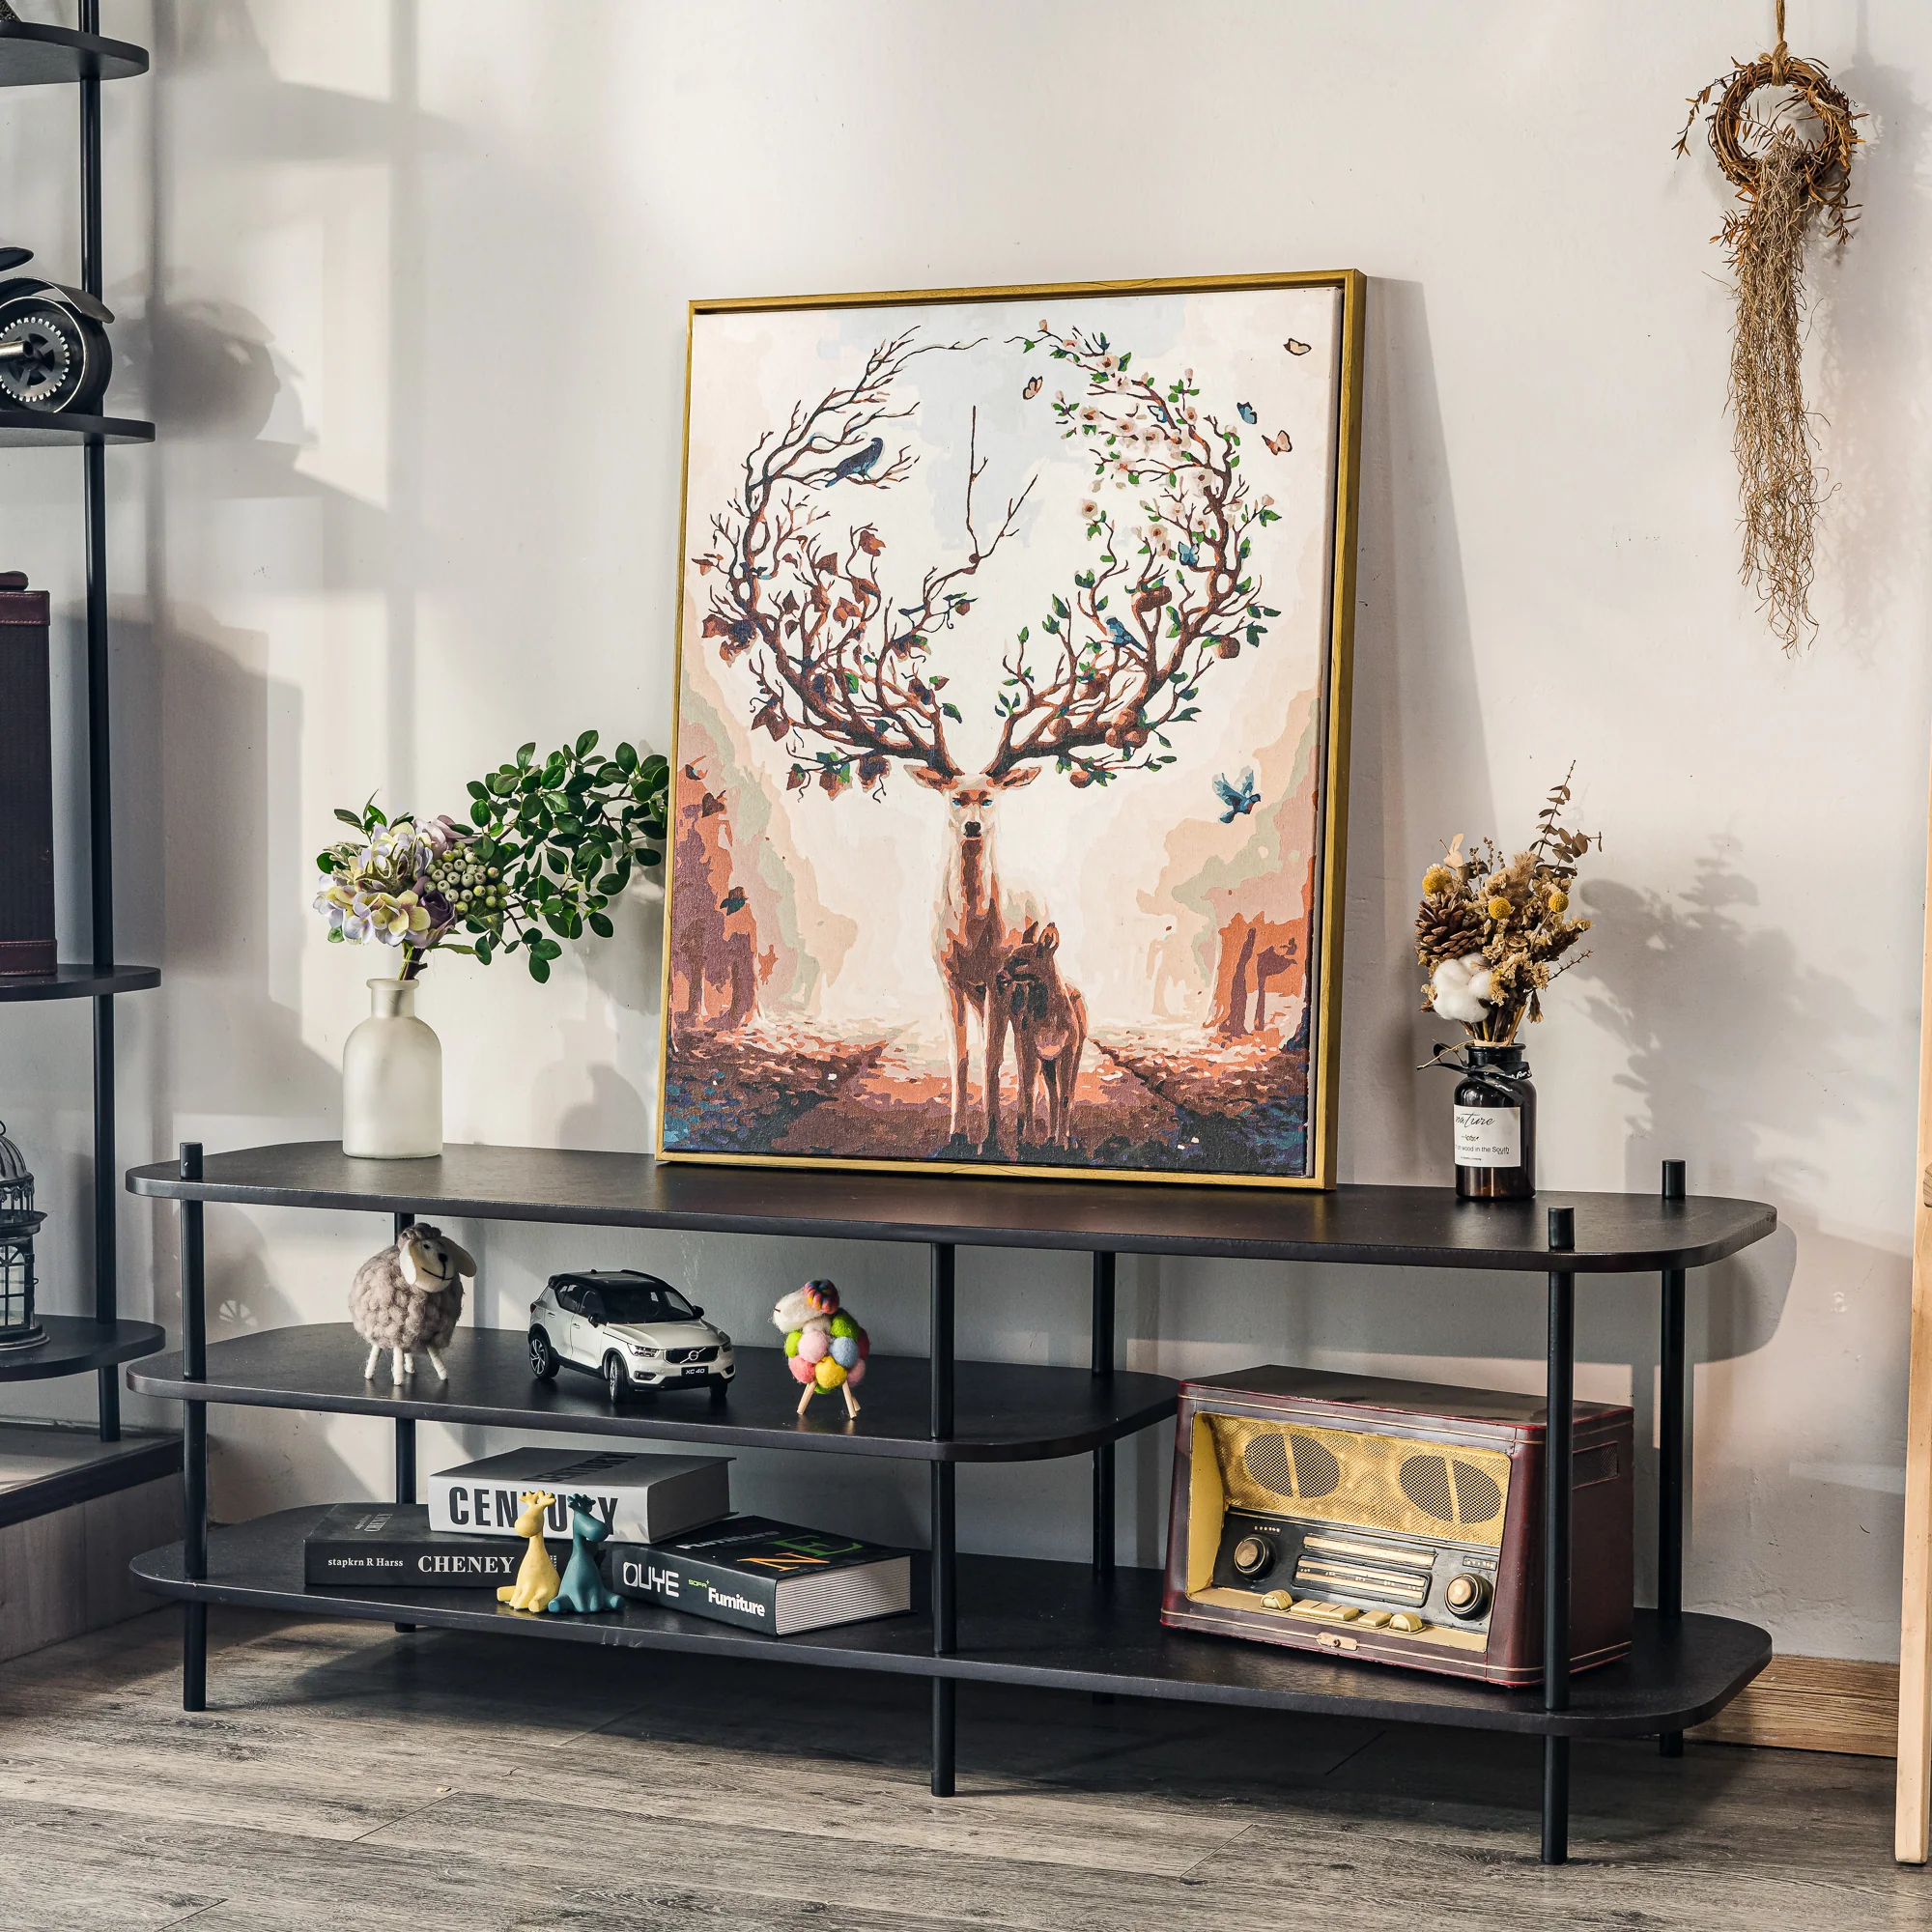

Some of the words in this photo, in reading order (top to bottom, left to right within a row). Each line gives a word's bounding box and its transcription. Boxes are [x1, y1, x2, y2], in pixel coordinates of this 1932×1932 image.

[448, 1486, 618, 1536] CENUY
[366, 1557, 374, 1567] R
[376, 1557, 404, 1567] Harss
[417, 1555, 515, 1574] CHENEY
